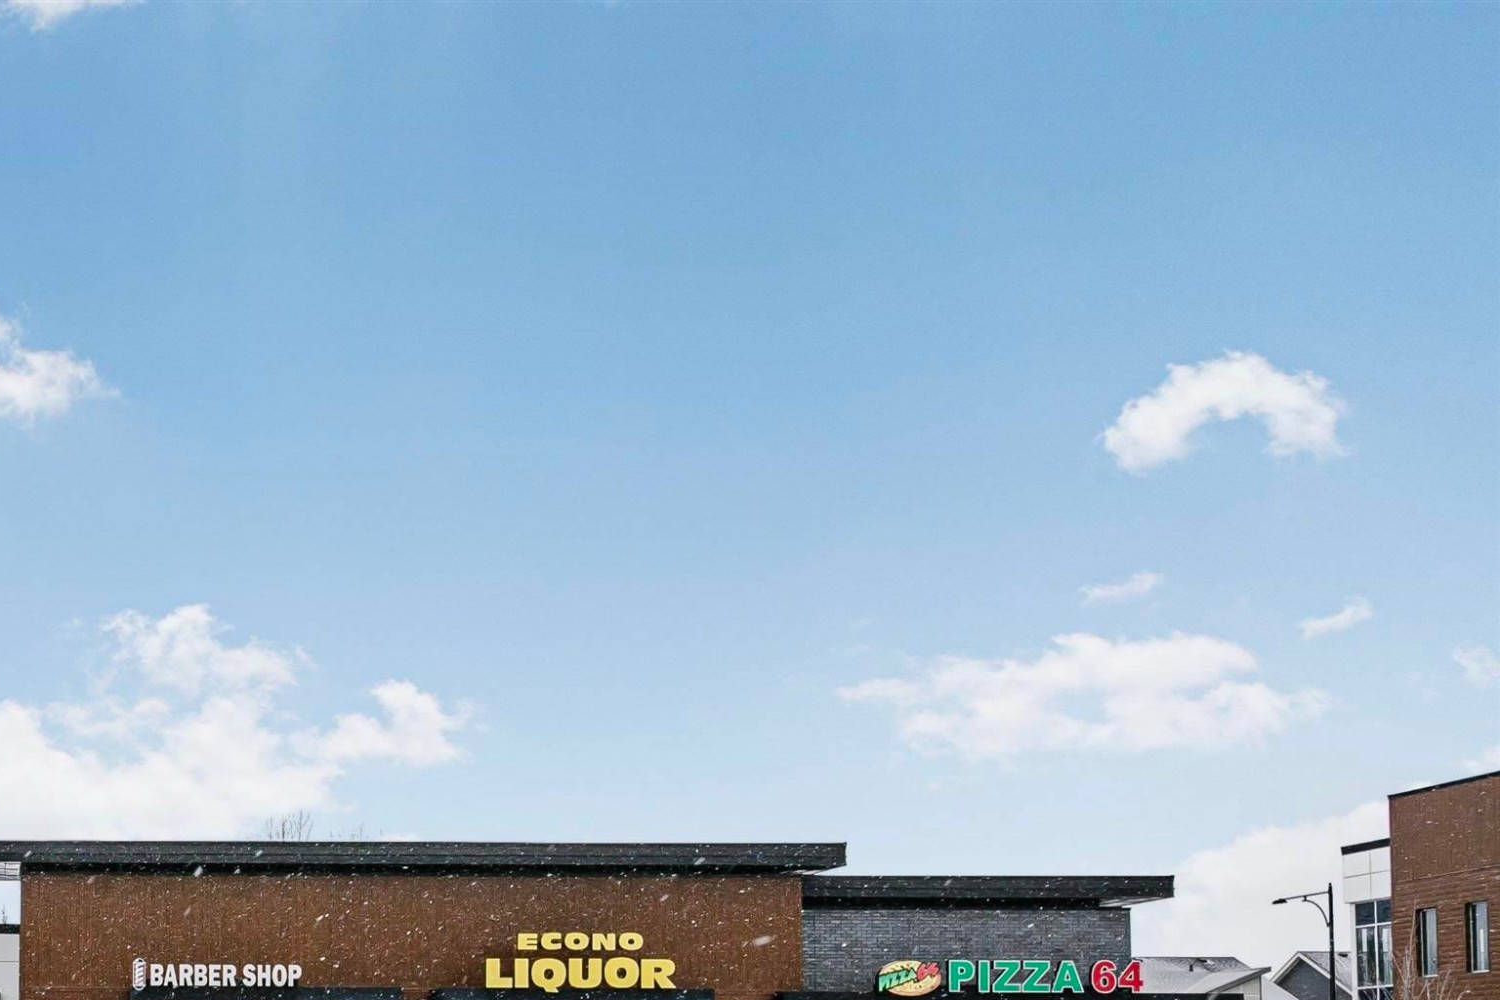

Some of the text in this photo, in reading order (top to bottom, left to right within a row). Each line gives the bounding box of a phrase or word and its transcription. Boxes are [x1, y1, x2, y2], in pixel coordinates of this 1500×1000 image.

[517, 932, 644, 951] ECONO
[150, 963, 303, 988] BARBER SHOP
[485, 957, 676, 993] LIQUOR
[878, 962, 939, 991] PIZZA 64
[947, 959, 1144, 994] PIZZA 64
